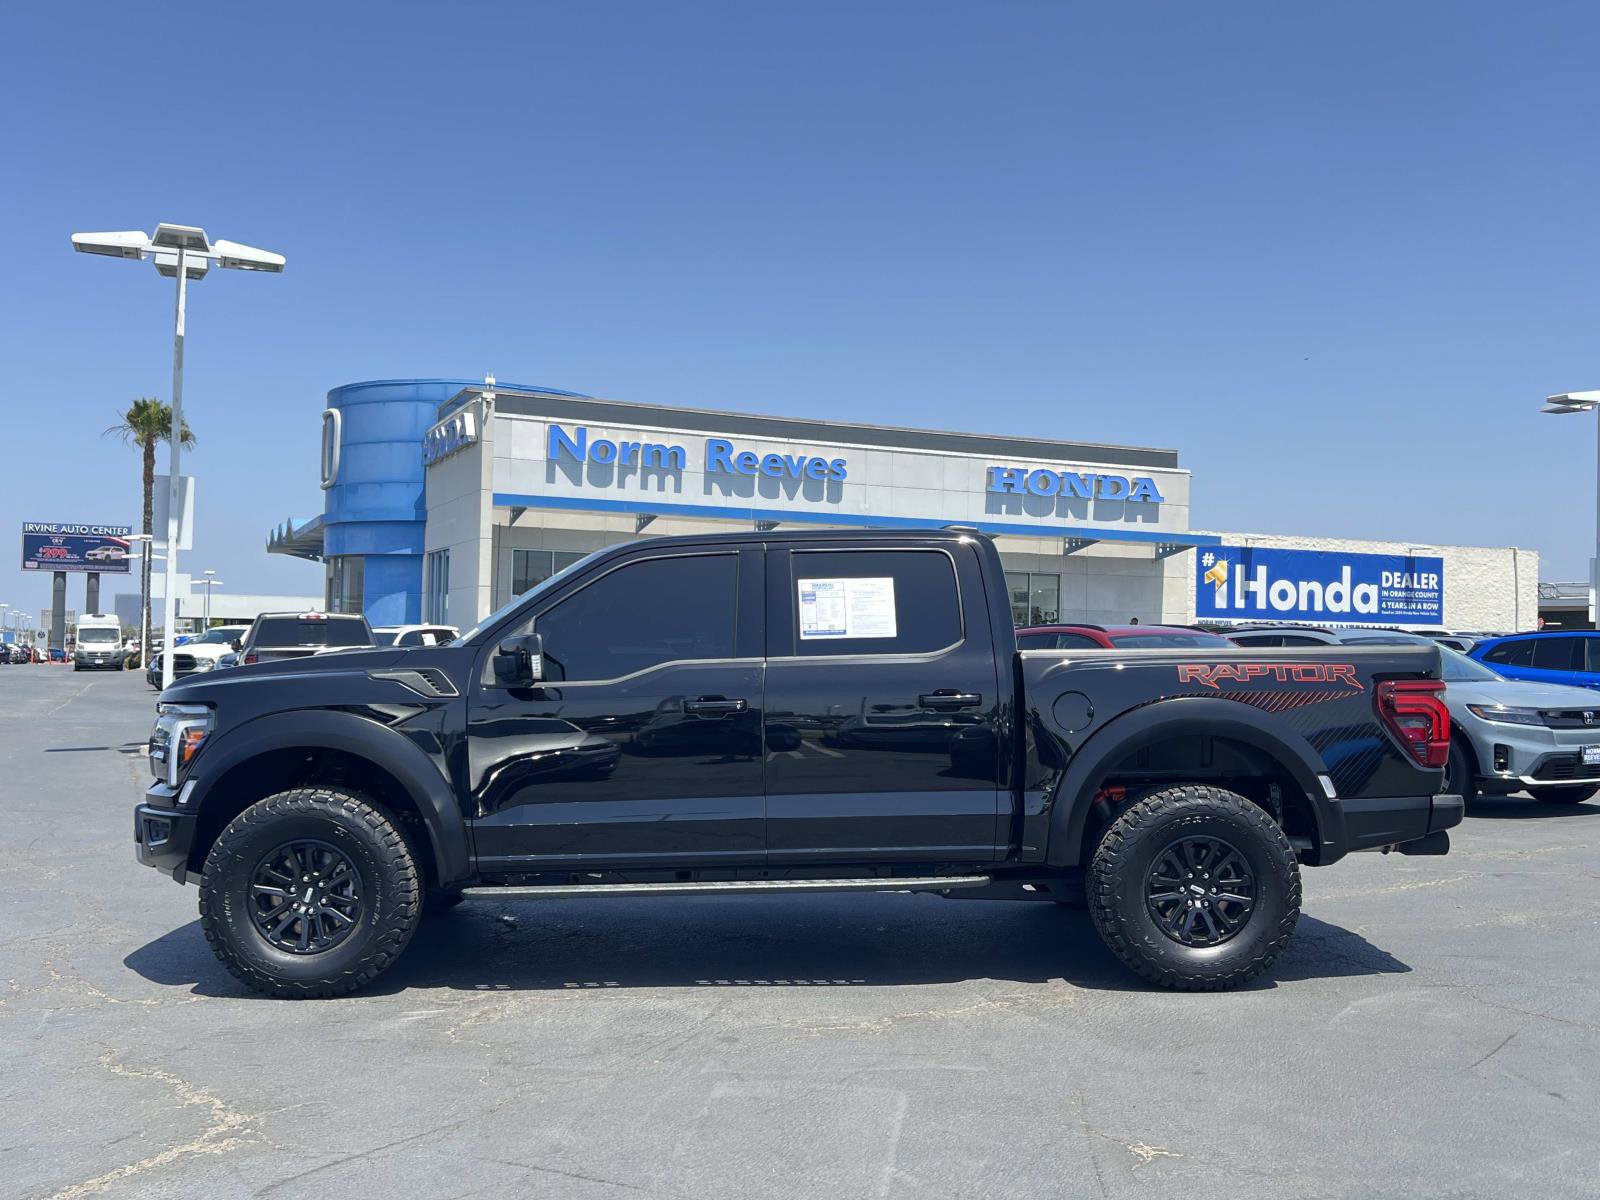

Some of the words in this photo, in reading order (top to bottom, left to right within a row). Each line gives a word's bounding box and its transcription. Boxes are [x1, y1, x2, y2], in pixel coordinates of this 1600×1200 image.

[547, 424, 686, 469] Norm
[705, 438, 848, 481] Reeves
[983, 466, 1165, 503] HONDA
[25, 523, 57, 533] IRVINE
[60, 525, 89, 534] AUTO
[91, 526, 129, 536] CENTER
[1234, 563, 1379, 613] Honda
[1381, 571, 1439, 590] DEALER
[1381, 601, 1387, 609] 4
[1387, 601, 1408, 610] YEARS
[1408, 602, 1416, 610] IN
[1416, 602, 1423, 610] A
[1422, 602, 1439, 610] ROW
[1389, 590, 1415, 598] ORANGE
[1414, 591, 1439, 599] COUNTY
[1177, 664, 1364, 689] RAPTOR
